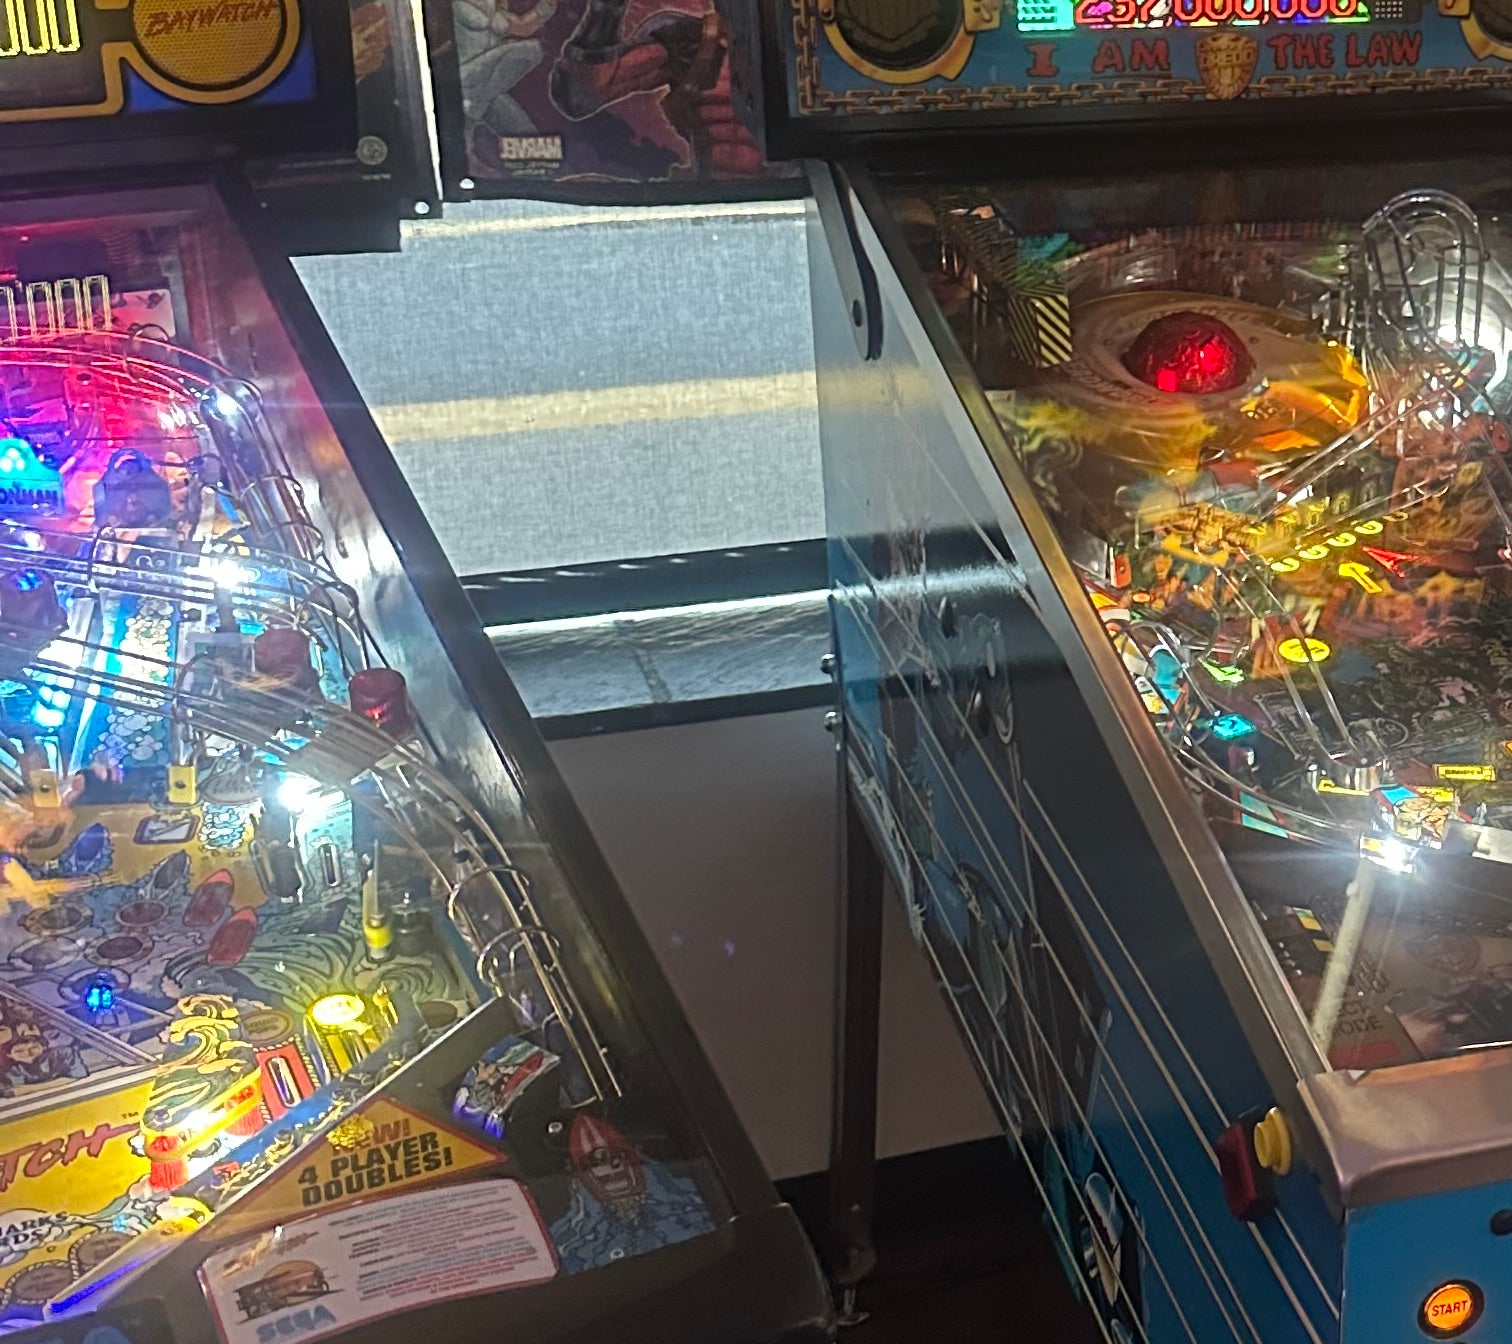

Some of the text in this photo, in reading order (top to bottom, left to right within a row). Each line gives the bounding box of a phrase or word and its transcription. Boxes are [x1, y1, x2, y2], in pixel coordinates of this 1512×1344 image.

[145, 0, 278, 37] BAYWATCH
[1026, 31, 1423, 77] I AM THE LAW
[297, 1131, 439, 1186] 4 PLAYER
[332, 1118, 411, 1157] EW!
[302, 1146, 454, 1208] DOUBLES!
[1431, 1299, 1468, 1317] START
